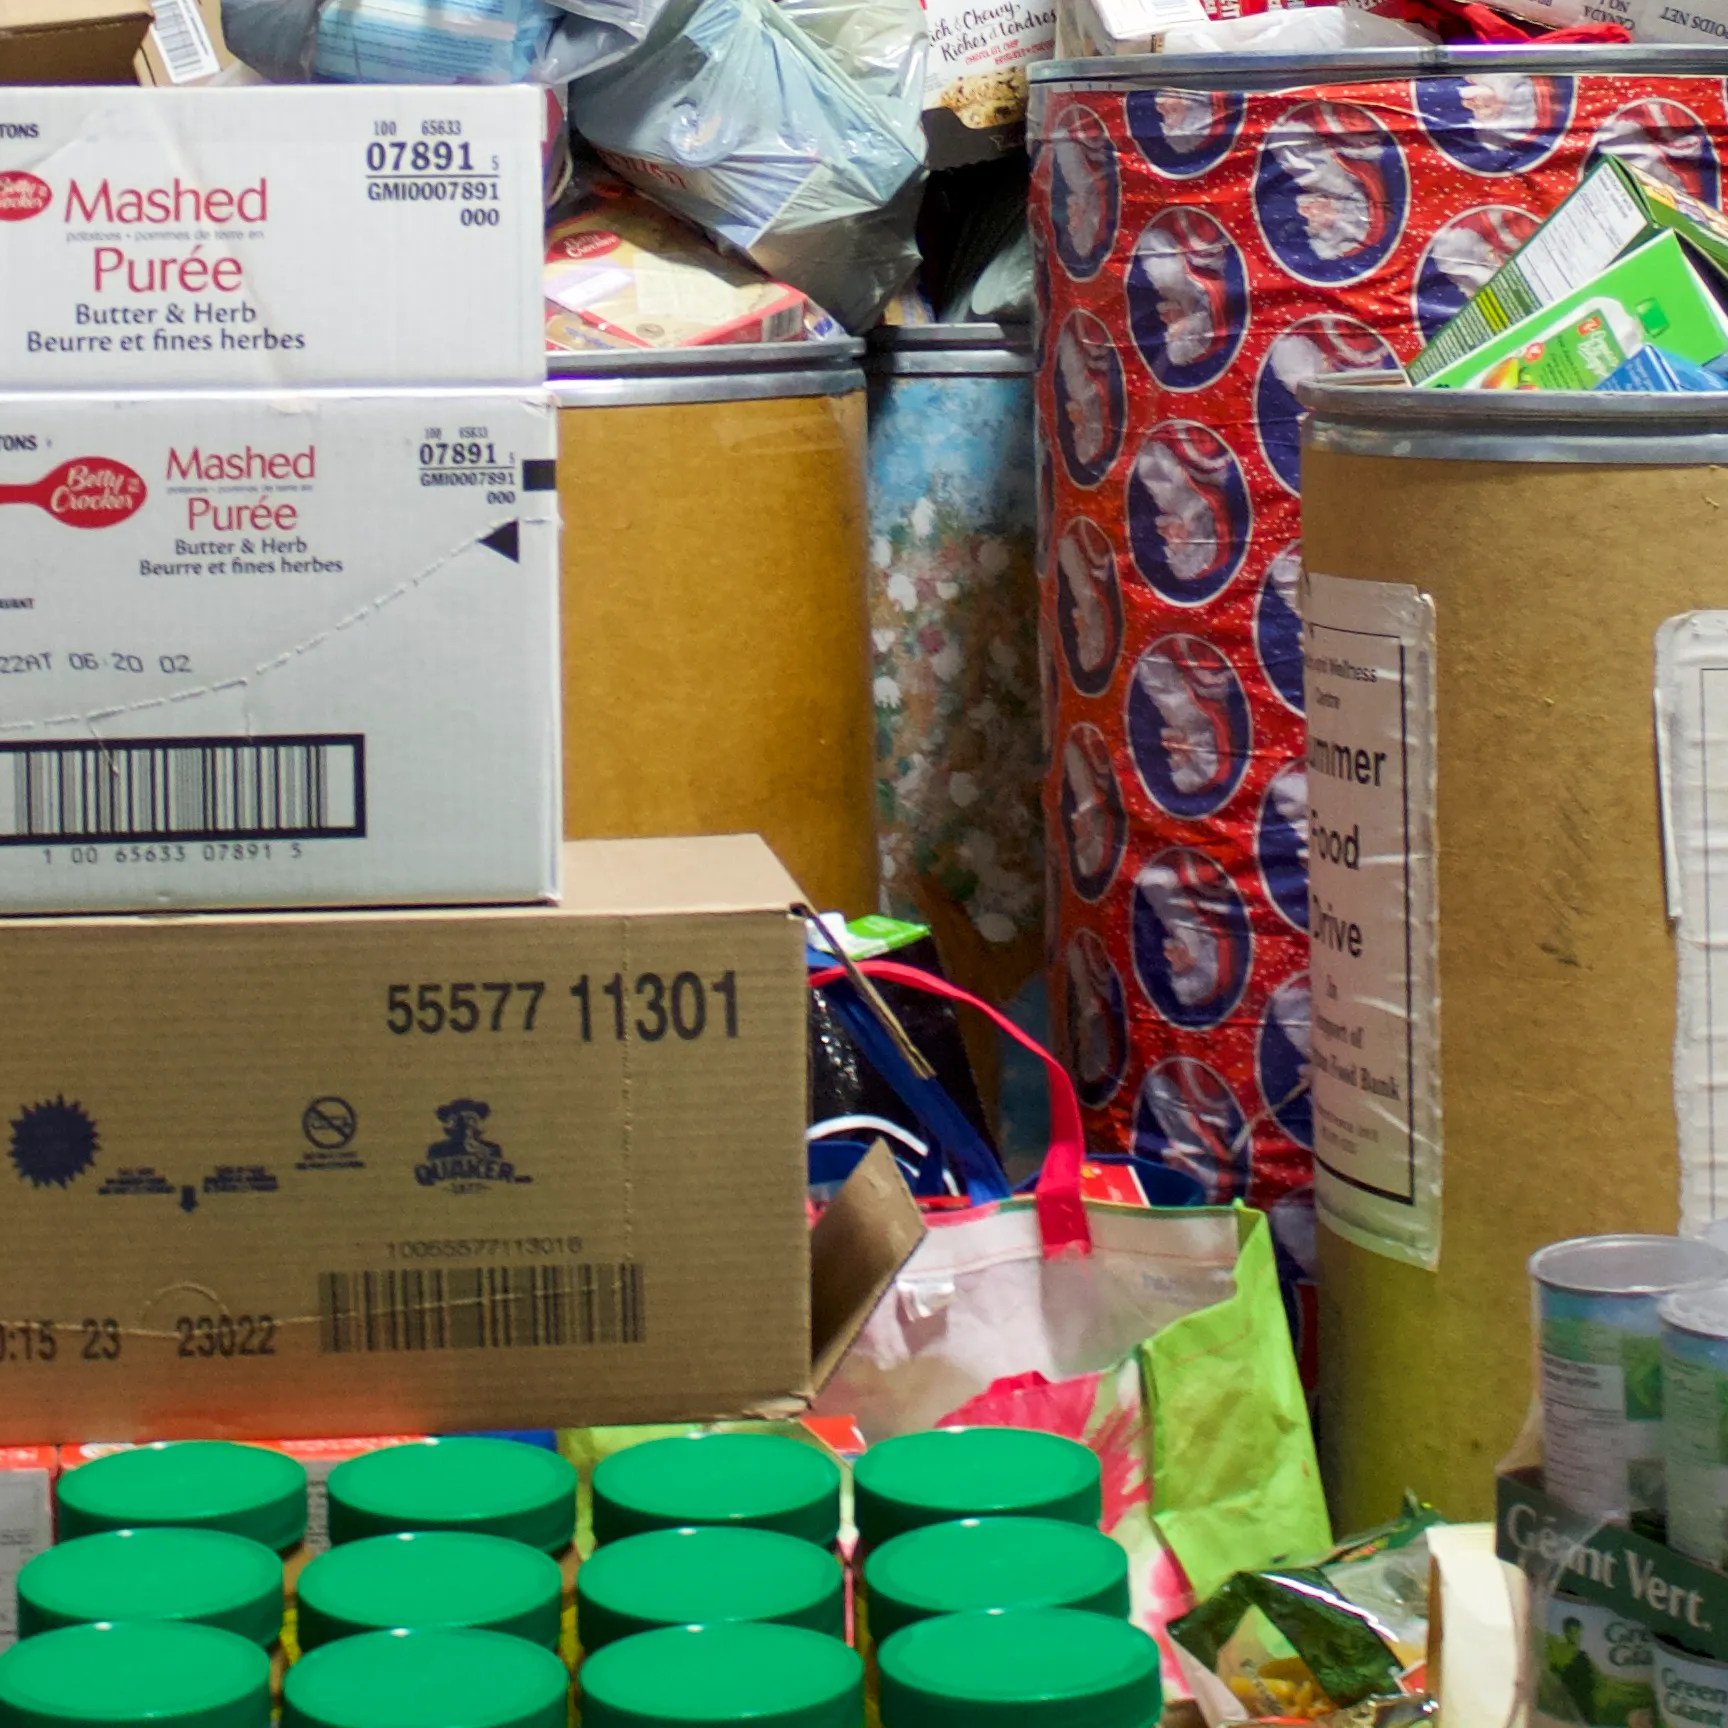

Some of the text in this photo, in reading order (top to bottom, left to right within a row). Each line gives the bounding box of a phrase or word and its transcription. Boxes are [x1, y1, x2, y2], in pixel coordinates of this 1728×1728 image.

[366, 142, 474, 171] 07891
[64, 178, 267, 224] Mashed
[461, 209, 499, 226] 000
[94, 245, 243, 293] Purée
[75, 302, 256, 325] Butter & Herb
[27, 330, 305, 353] Beurre et fines herbes
[167, 445, 315, 482] Mashed
[420, 443, 496, 464] 07891
[67, 465, 124, 491] Betty
[51, 485, 133, 513] Crocker
[487, 491, 515, 504] 000
[188, 496, 298, 532] Purée
[175, 538, 307, 555] Butter & Herb
[140, 557, 344, 576] Beurre et fines herbes
[387, 970, 739, 1042] 55577 11301
[413, 1159, 515, 1186] QUAKER
[81, 1321, 121, 1360] 23
[177, 1316, 276, 1357] 23022
